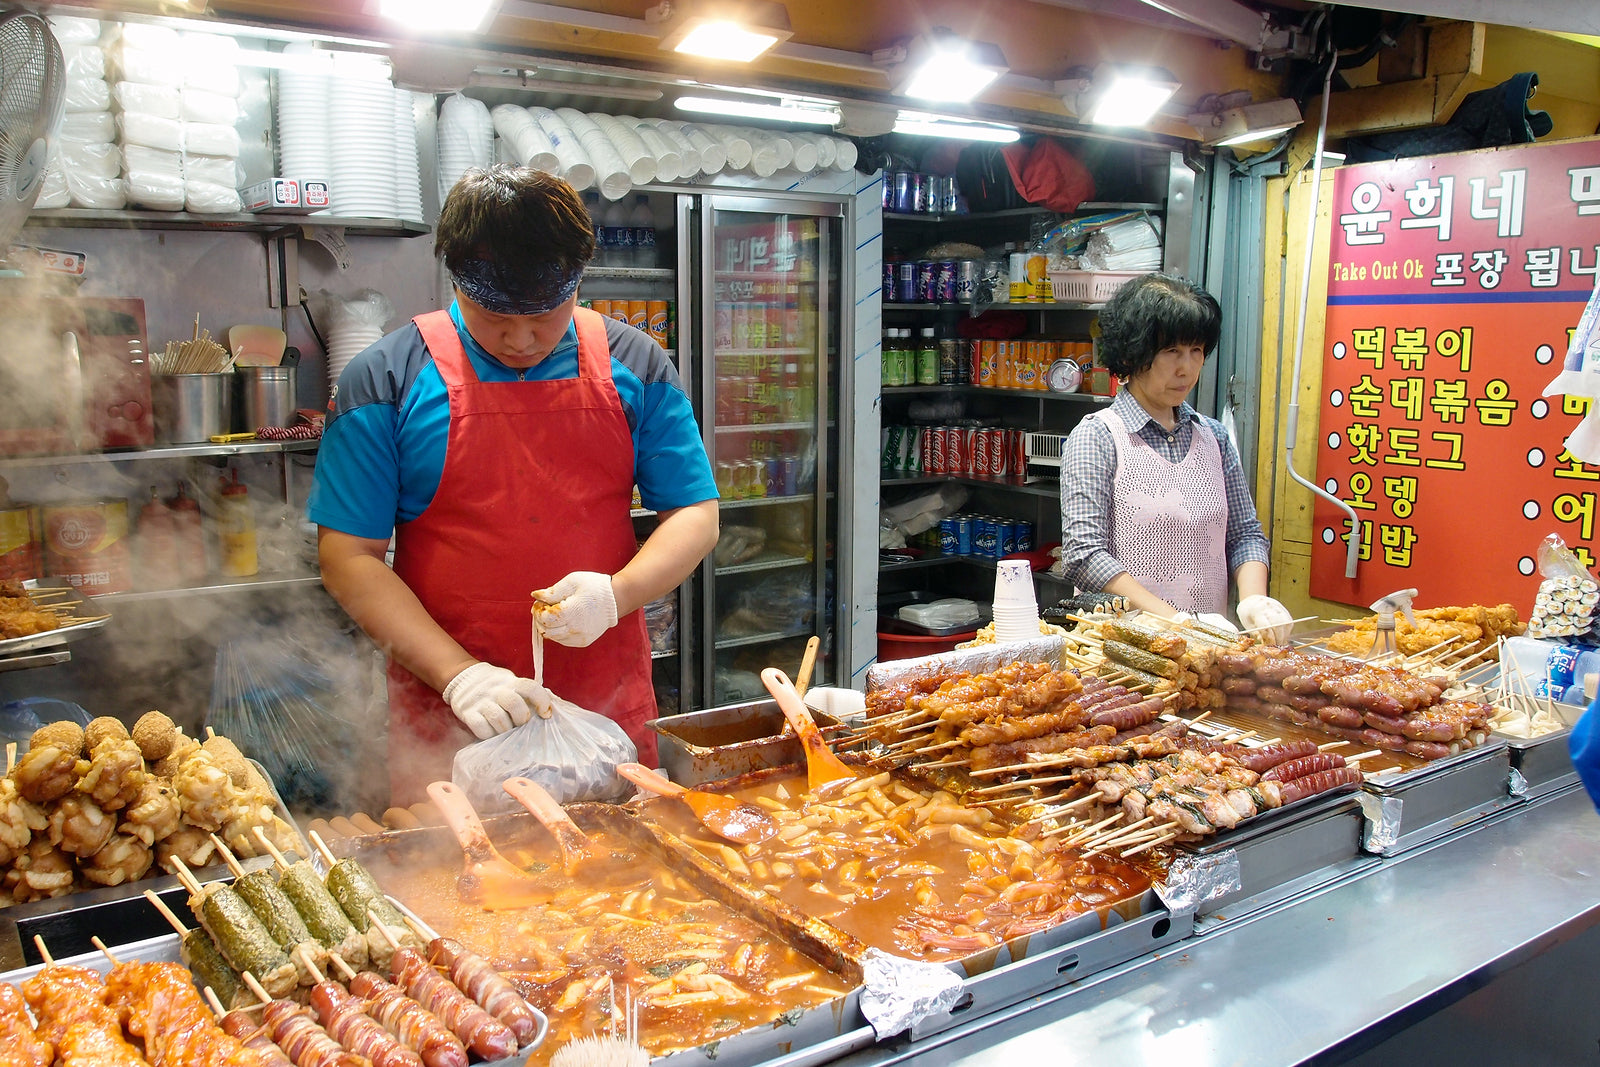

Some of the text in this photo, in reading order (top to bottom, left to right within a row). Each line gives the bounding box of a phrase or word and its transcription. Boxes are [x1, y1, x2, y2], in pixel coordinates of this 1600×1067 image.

[1340, 168, 1528, 246] 윤희네
[1334, 259, 1424, 281] Take Out Ok
[1431, 249, 1509, 289] 포장
[1352, 326, 1474, 372] 떡볶이
[1348, 375, 1518, 427] 순대볶음
[1346, 423, 1466, 470] 핫도그
[1343, 472, 1418, 519] 오뎅
[1340, 519, 1418, 568] 김밥
[1557, 653, 1573, 674] Icis
